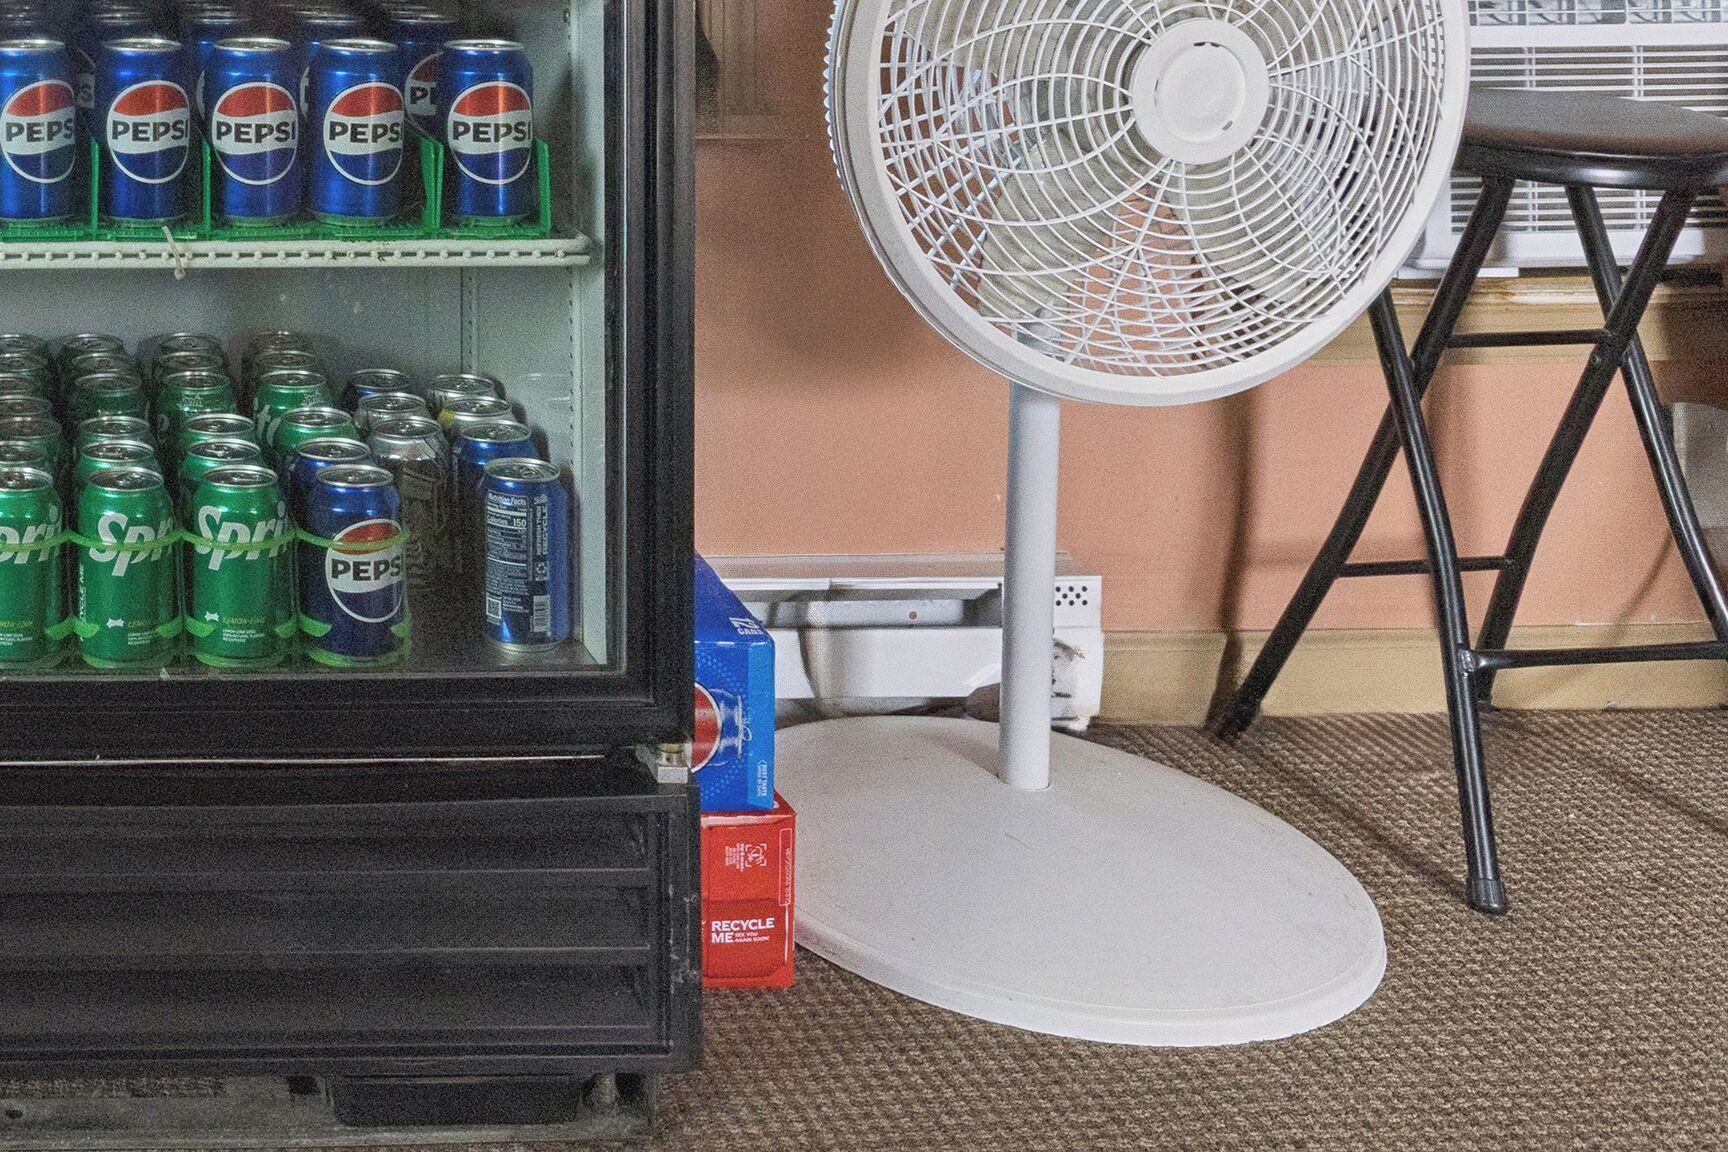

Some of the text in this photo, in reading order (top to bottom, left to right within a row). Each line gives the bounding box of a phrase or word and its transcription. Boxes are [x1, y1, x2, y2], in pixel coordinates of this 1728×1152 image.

[5, 119, 75, 143] PEPS
[216, 120, 297, 144] PEPSI
[511, 497, 527, 506] Facts
[512, 518, 527, 528] 150
[331, 555, 401, 582] PEPS
[712, 917, 775, 932] RECYCLE
[712, 932, 735, 944] ME
